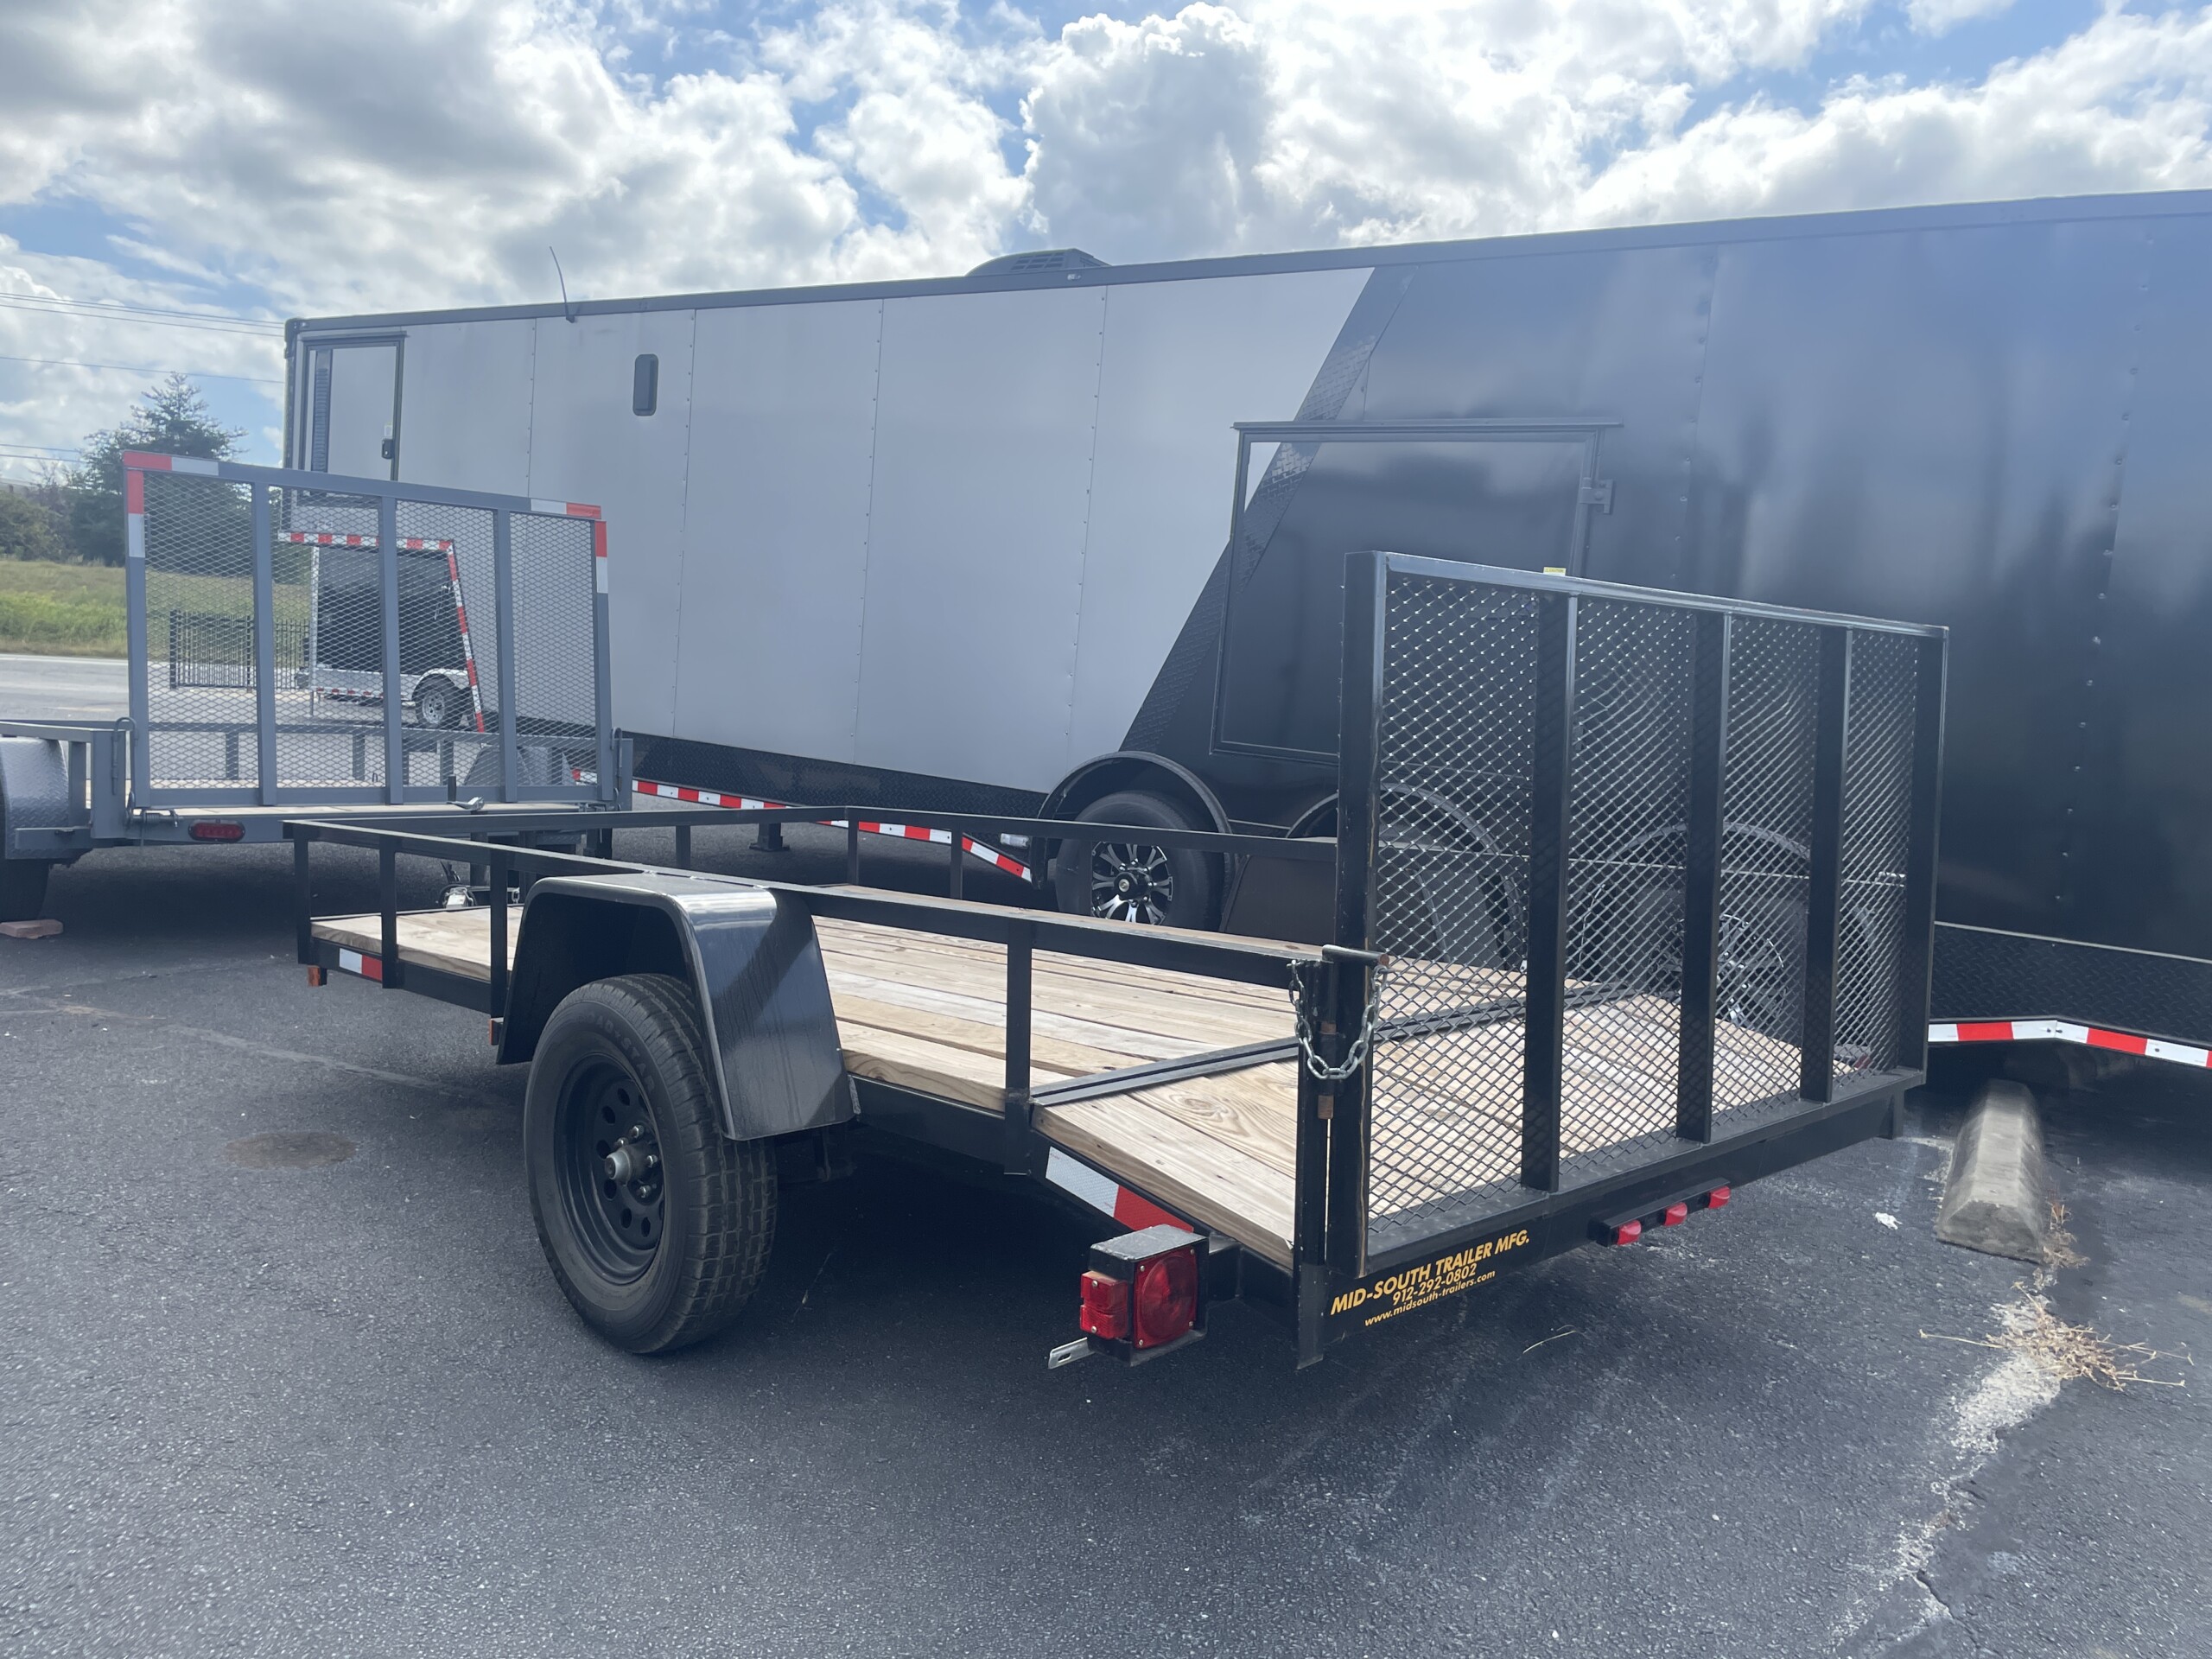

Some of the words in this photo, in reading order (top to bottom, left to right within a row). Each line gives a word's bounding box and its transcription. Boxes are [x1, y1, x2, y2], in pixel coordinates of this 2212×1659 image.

[1331, 1263, 1431, 1315] MID-SOUTH
[1435, 1242, 1492, 1276] TRAILER
[1494, 1230, 1529, 1255] MFG.
[1364, 1269, 1496, 1326] www.midsouth-trailers.com
[1392, 1263, 1477, 1306] 912-292-0802
